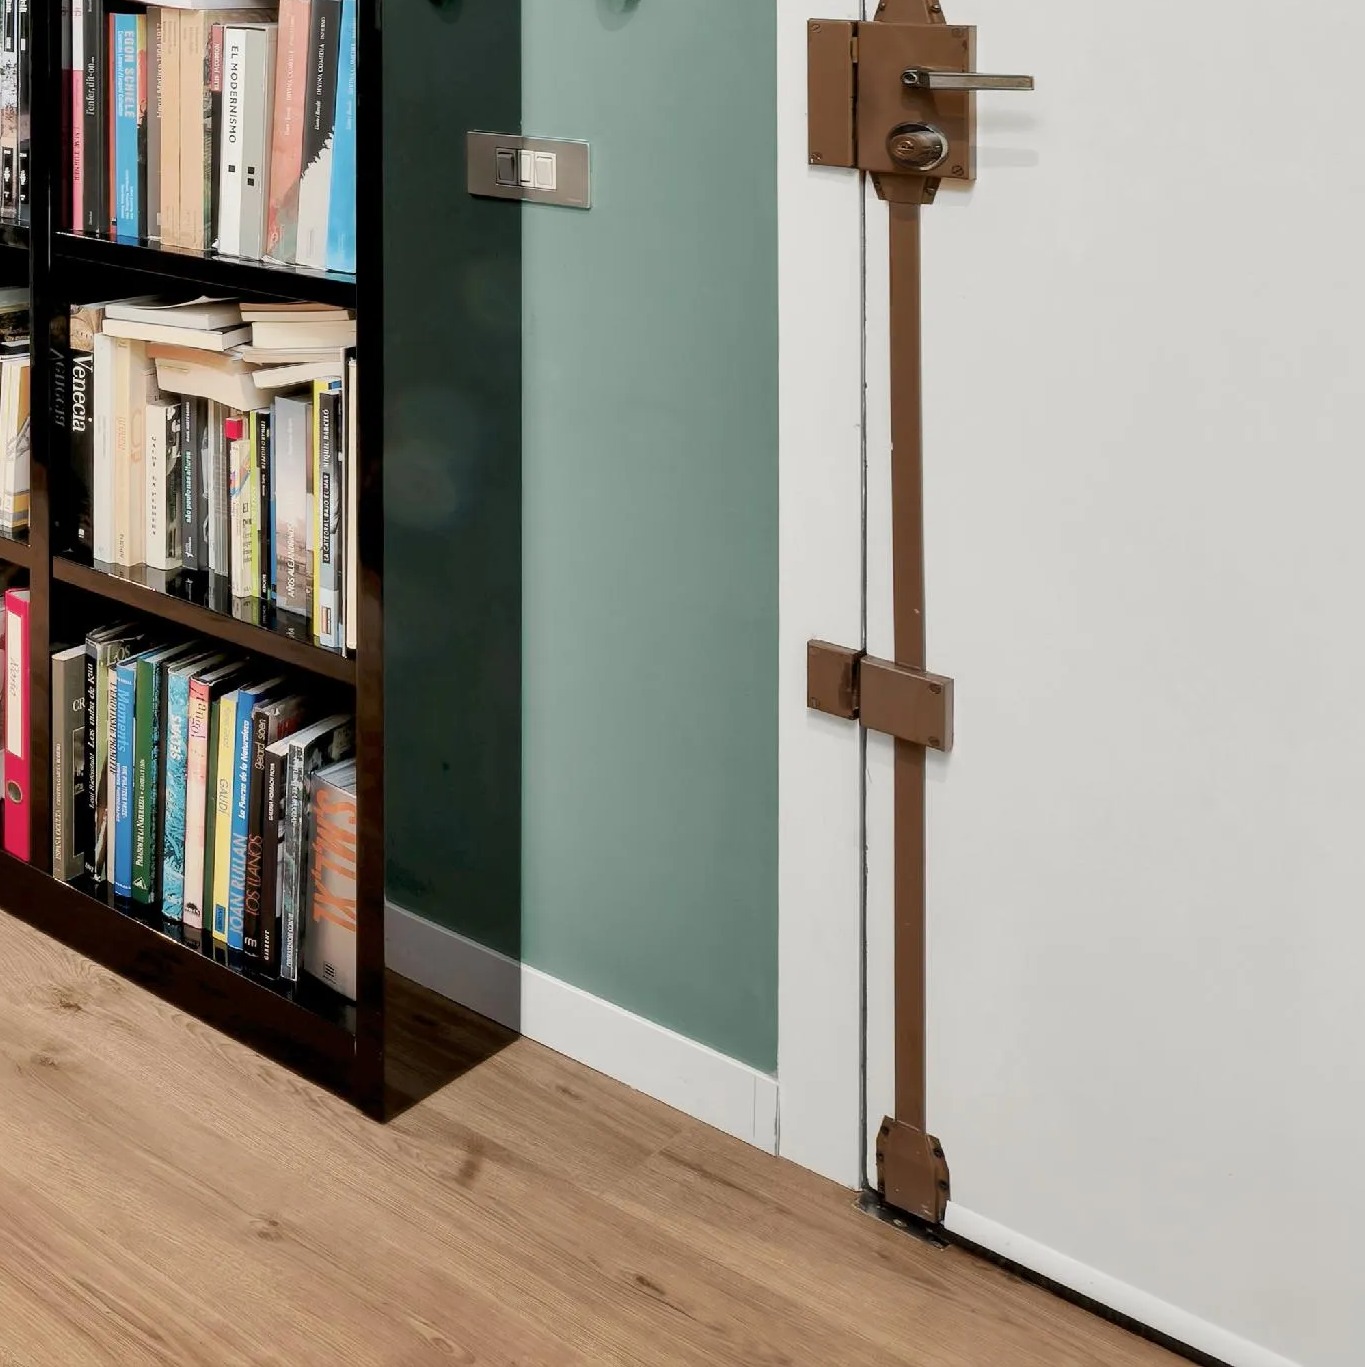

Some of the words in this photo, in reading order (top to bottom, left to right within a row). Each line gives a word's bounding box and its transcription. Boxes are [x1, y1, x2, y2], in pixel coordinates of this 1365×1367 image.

[123, 30, 135, 63] EGON
[230, 45, 240, 60] EL
[124, 67, 136, 119] SCHIELE
[228, 63, 239, 144] MODERNISMO
[72, 353, 94, 432] Venecia
[286, 577, 295, 598] AÑOS
[87, 663, 95, 684] Kau
[116, 688, 131, 753] Moments
[170, 714, 181, 760] SELVAS
[240, 719, 250, 762] Naturaleza
[256, 718, 267, 740] sioen
[254, 742, 267, 771] gerard
[218, 778, 230, 815] GAUDÍ
[238, 783, 247, 808] Fuerza
[230, 833, 247, 890] RULLAN
[248, 833, 263, 887] LLANOS
[229, 892, 245, 936] JOAN
[247, 889, 261, 916] LOS
